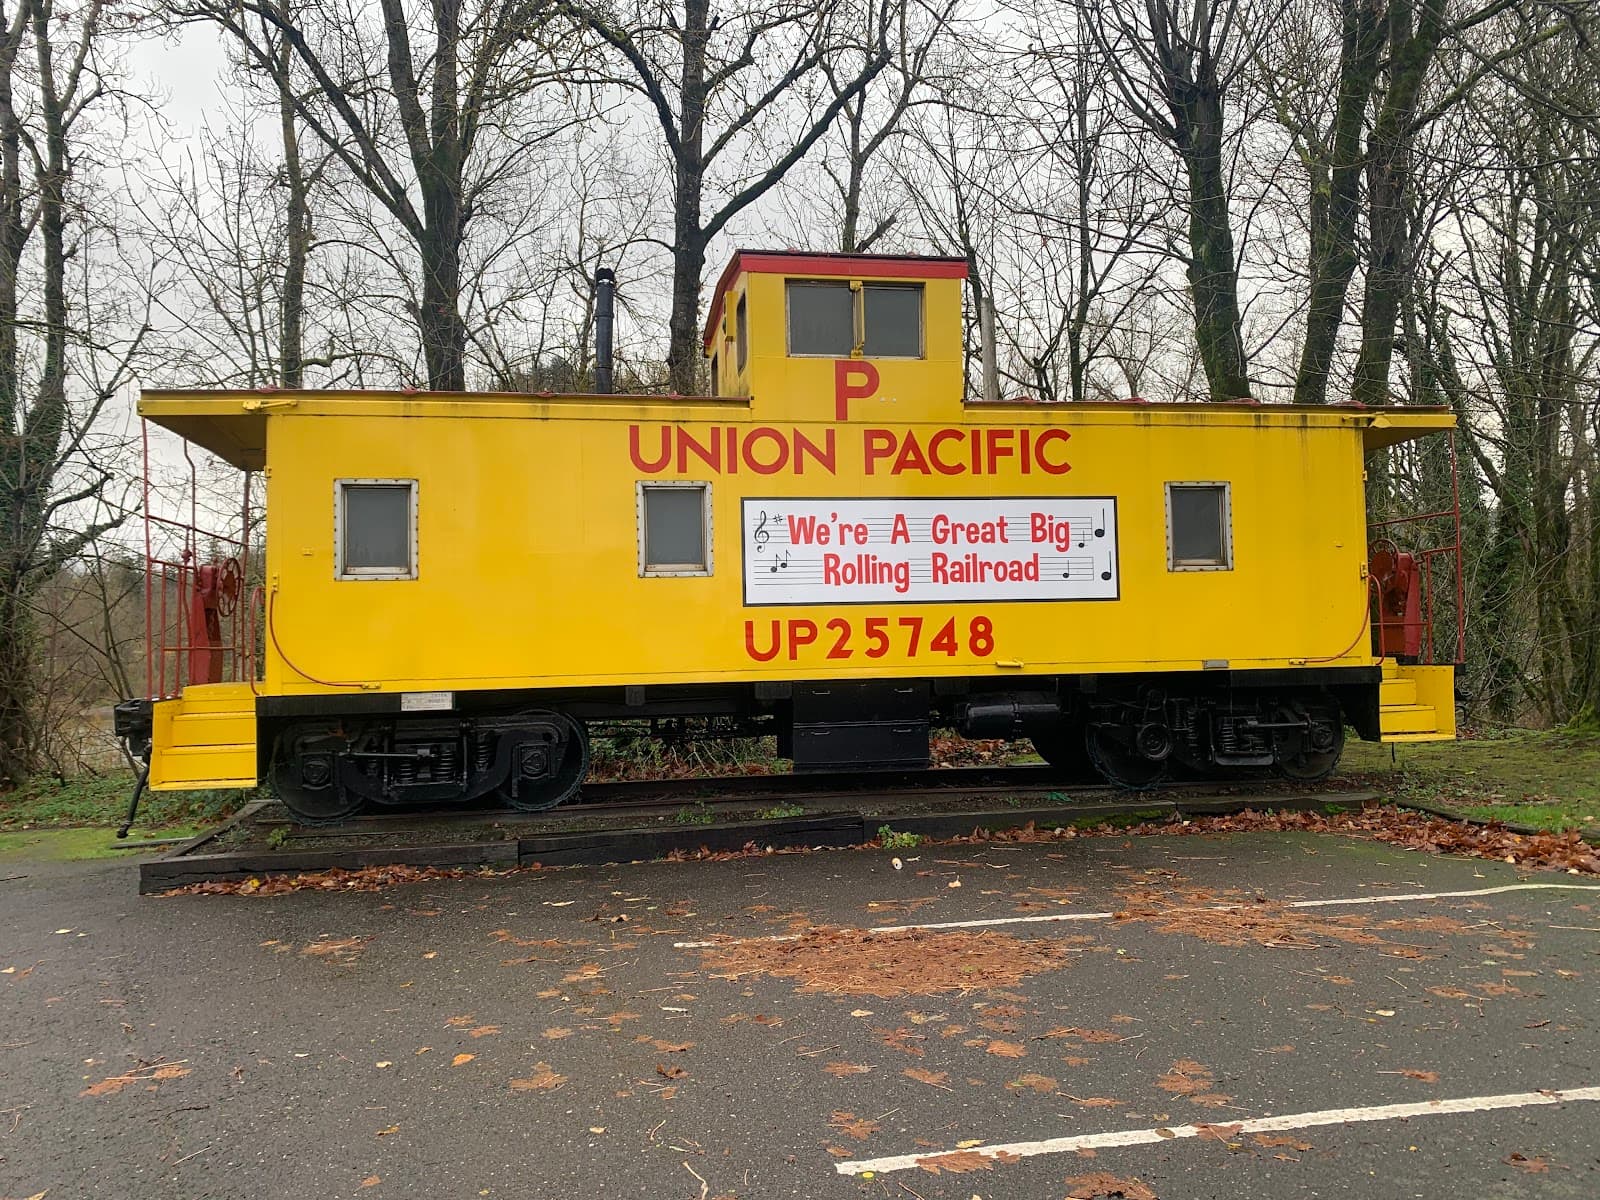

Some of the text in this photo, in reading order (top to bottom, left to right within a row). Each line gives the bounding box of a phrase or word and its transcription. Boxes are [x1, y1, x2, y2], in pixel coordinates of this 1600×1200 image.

[835, 360, 880, 421] P
[629, 426, 1072, 475] UNION PACIFIC
[787, 512, 1071, 552] We're A Great Big
[823, 552, 1040, 593] Rolling Railroad
